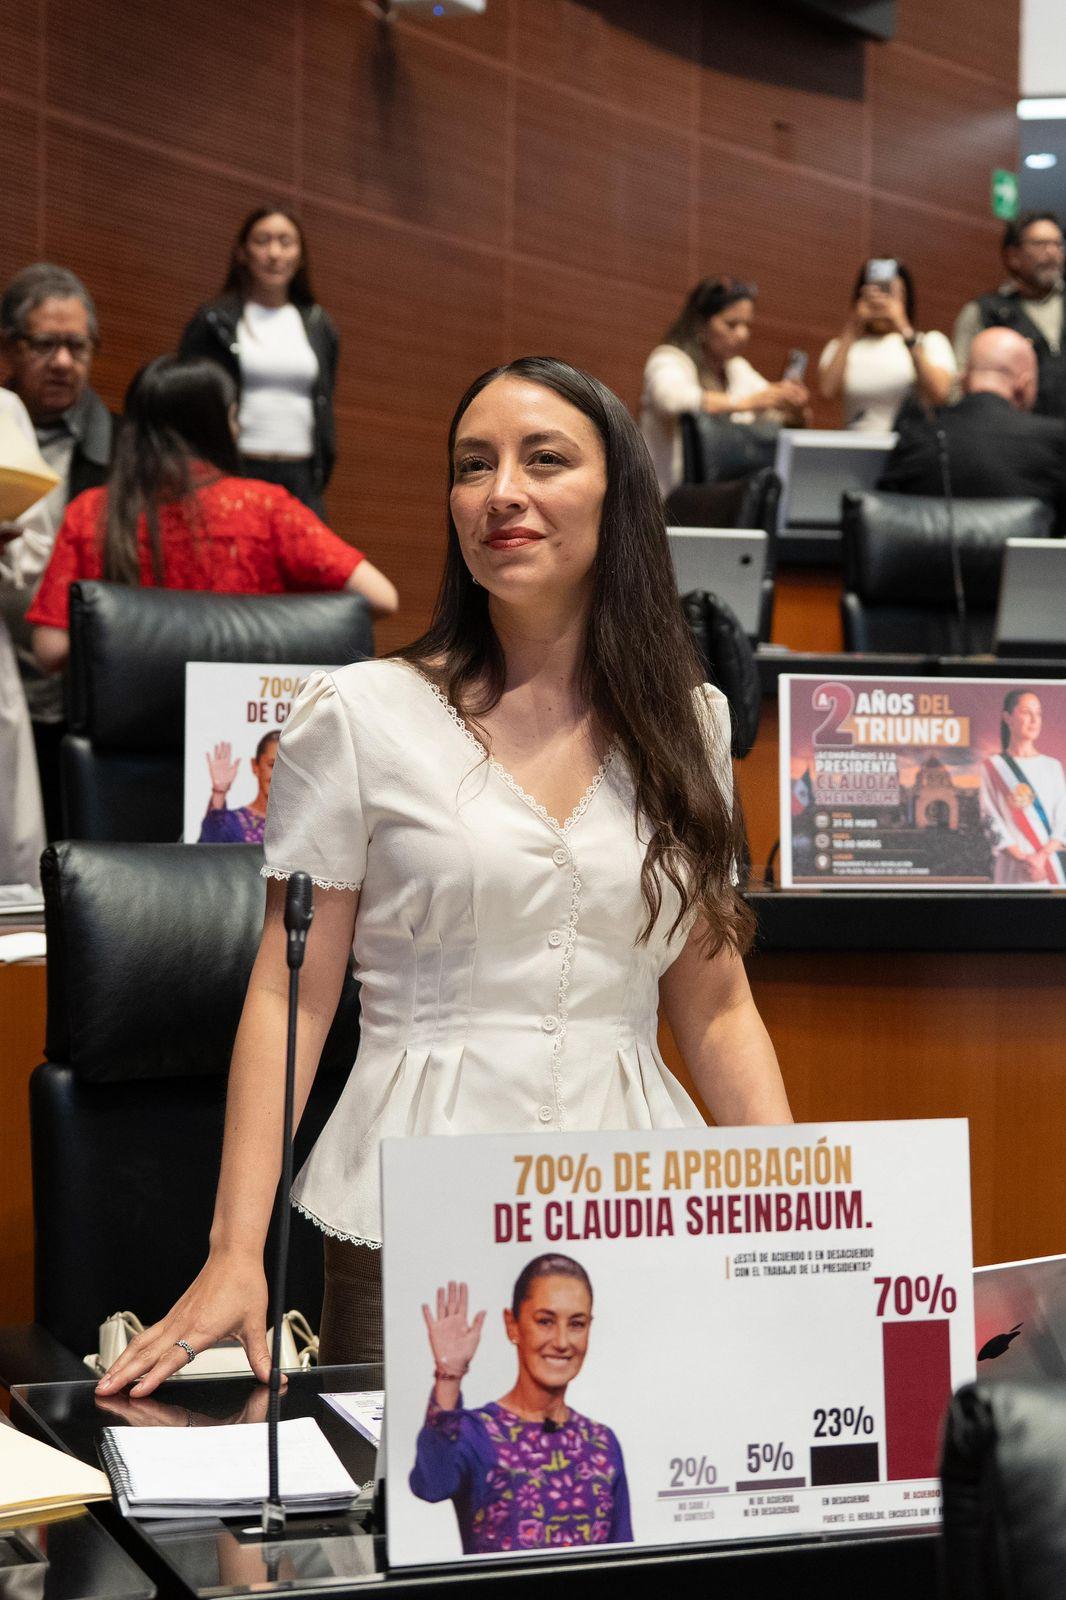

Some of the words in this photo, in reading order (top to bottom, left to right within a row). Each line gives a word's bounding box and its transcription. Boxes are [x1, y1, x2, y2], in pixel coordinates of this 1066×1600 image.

[818, 693, 828, 706] A
[855, 689, 915, 715] AÑOS
[919, 694, 954, 715] DEL
[247, 701, 268, 723] DE
[811, 682, 855, 748] 2
[854, 718, 961, 745] TRIUNFO
[815, 760, 897, 773] PRESIDENTA
[816, 774, 897, 789] CLAUDIA
[514, 1153, 602, 1195] 70%
[614, 1151, 651, 1192] DE
[663, 1136, 852, 1190] APROBACIÓN
[494, 1202, 532, 1243] DE
[545, 1197, 674, 1241] CLAUDIA
[686, 1190, 873, 1235] SHEINBAUM.
[734, 1251, 756, 1264] ¿ESTÁ
[759, 1252, 768, 1263] DE
[771, 1250, 805, 1262] ACUERDO
[807, 1250, 812, 1261] O
[815, 1250, 824, 1260] EN
[827, 1248, 874, 1260] DESACUERDO
[734, 1266, 749, 1277] CON
[752, 1266, 760, 1277] EL
[763, 1264, 797, 1276] TRABAJO
[799, 1264, 808, 1275] DE
[811, 1263, 820, 1274] LA
[822, 1261, 872, 1273] PRESIDENTA?
[873, 1274, 957, 1317] 70%
[813, 1406, 874, 1438] 23%
[747, 1442, 794, 1473] 5%
[669, 1456, 717, 1487] 2%
[767, 1494, 794, 1504] ACUERDO
[822, 1497, 829, 1506] EN
[831, 1494, 870, 1505] DESACUERDO
[912, 1489, 940, 1499] ACUERDO
[761, 1505, 800, 1515] DESACUERDO
